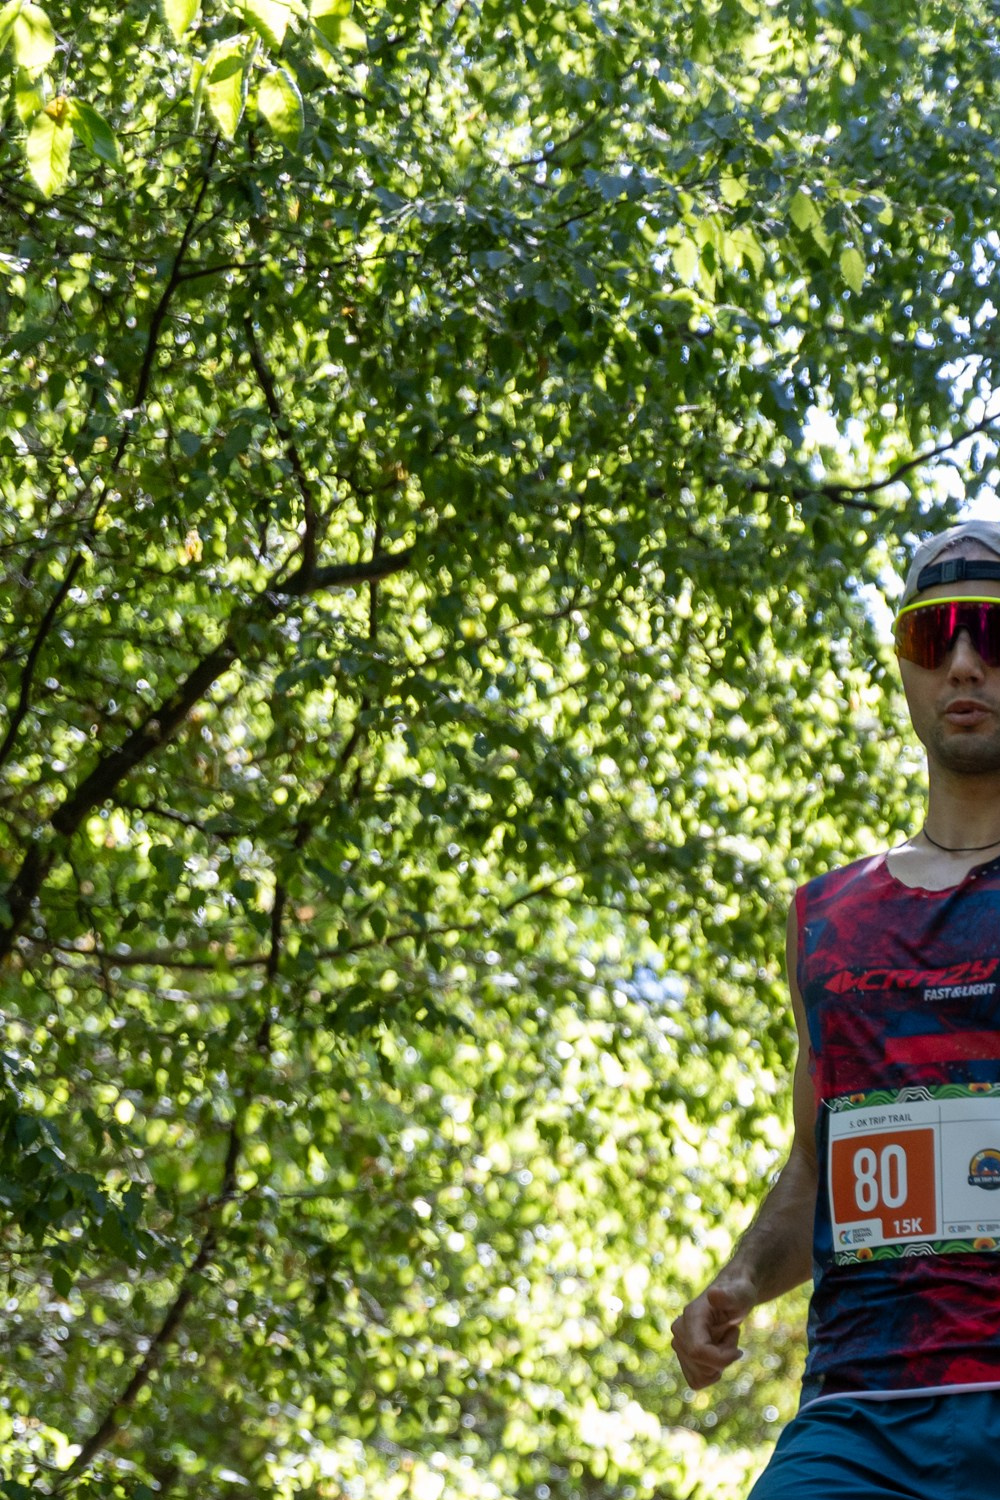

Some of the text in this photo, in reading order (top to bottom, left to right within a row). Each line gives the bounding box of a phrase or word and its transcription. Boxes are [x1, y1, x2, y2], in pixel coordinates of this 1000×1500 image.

[857, 958, 1000, 991] CRAZY
[924, 983, 997, 1001] FAST&LIGHT
[869, 1115, 887, 1126] TRIP
[888, 1113, 913, 1123] TRAIL
[853, 1144, 908, 1212] 80
[893, 1217, 923, 1234] 15K
